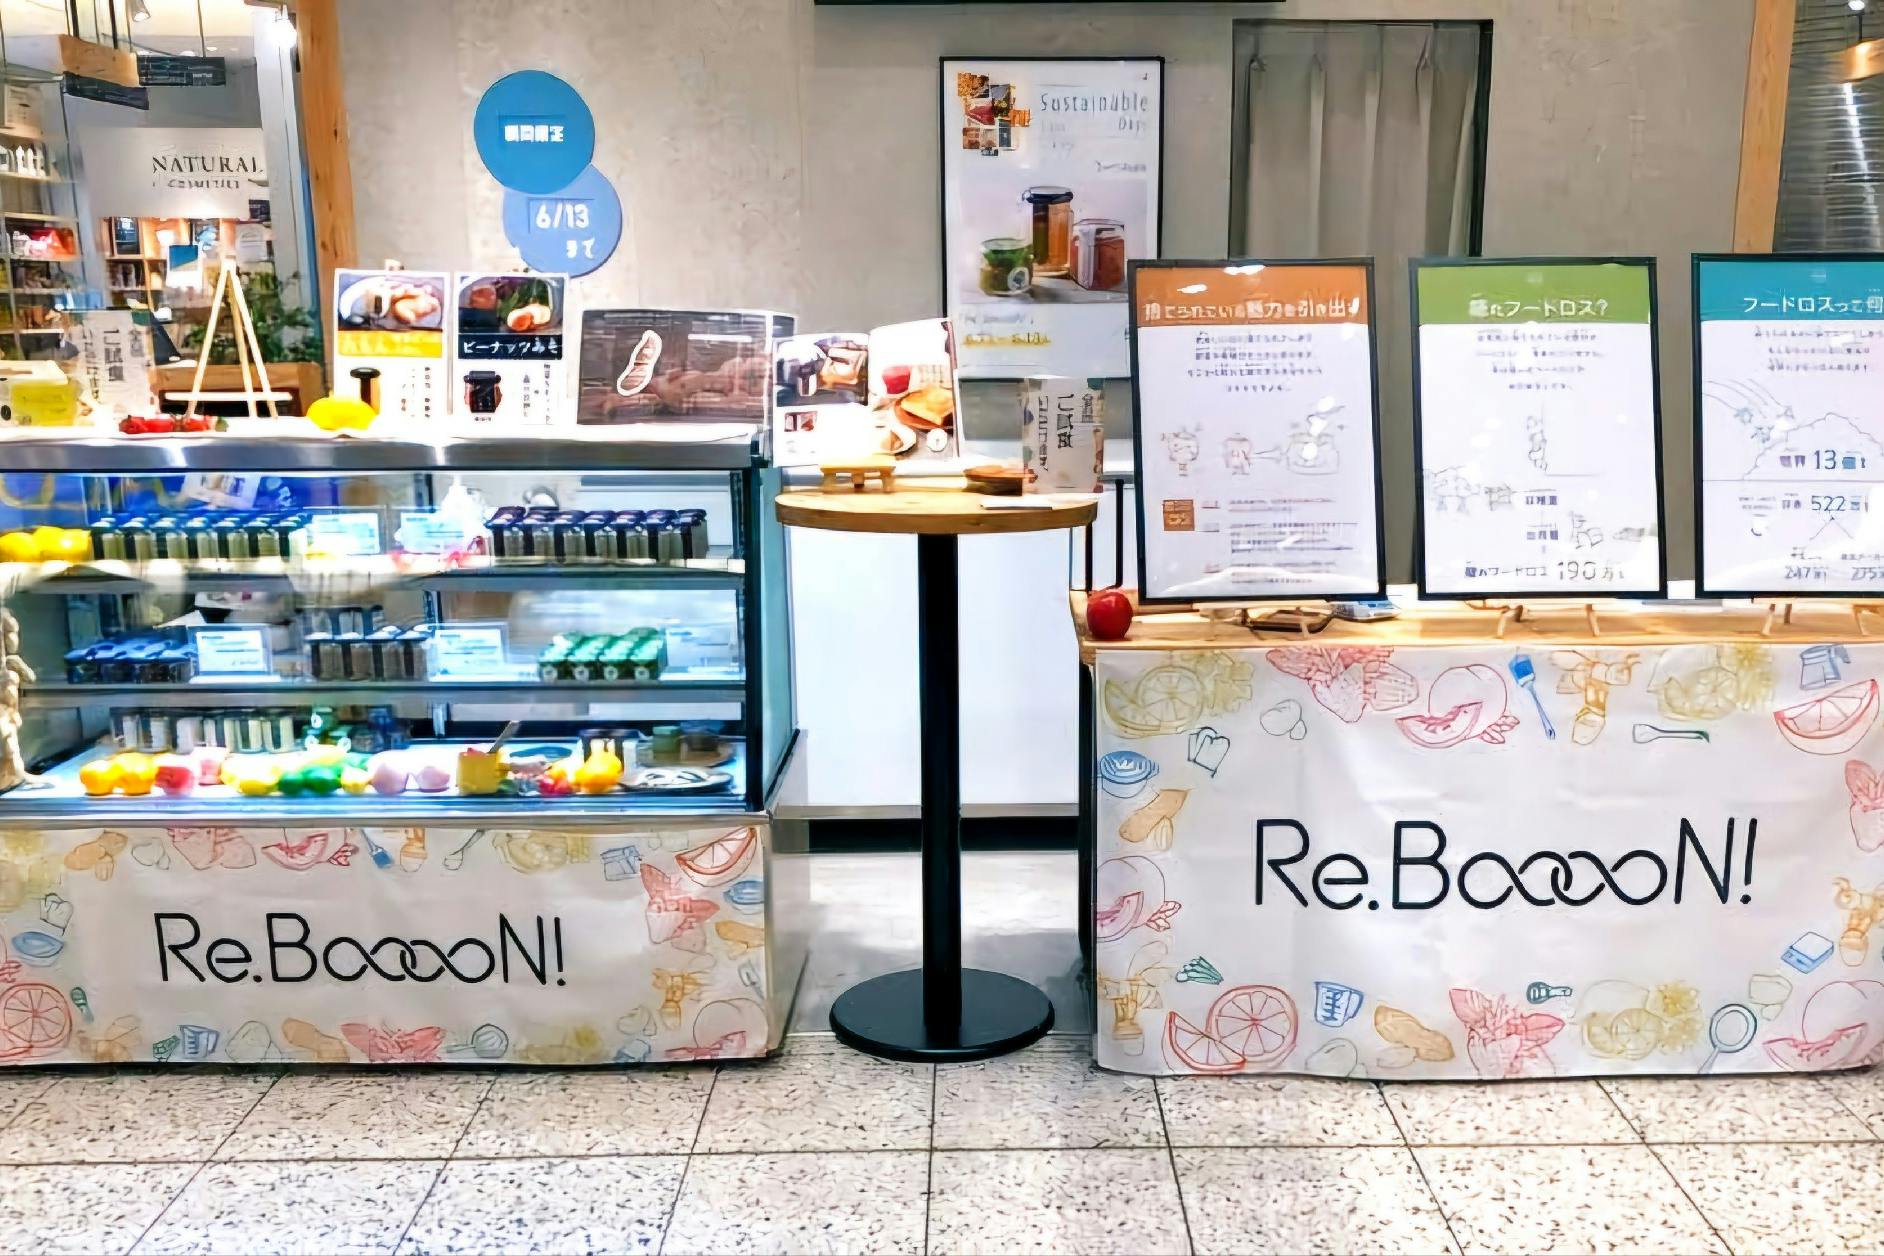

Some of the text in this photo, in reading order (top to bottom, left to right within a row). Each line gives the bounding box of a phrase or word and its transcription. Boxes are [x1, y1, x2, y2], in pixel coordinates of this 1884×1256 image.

[152, 156, 264, 173] NATURAL
[536, 203, 589, 229] 6/13
[1469, 297, 1608, 318] れフードロス?
